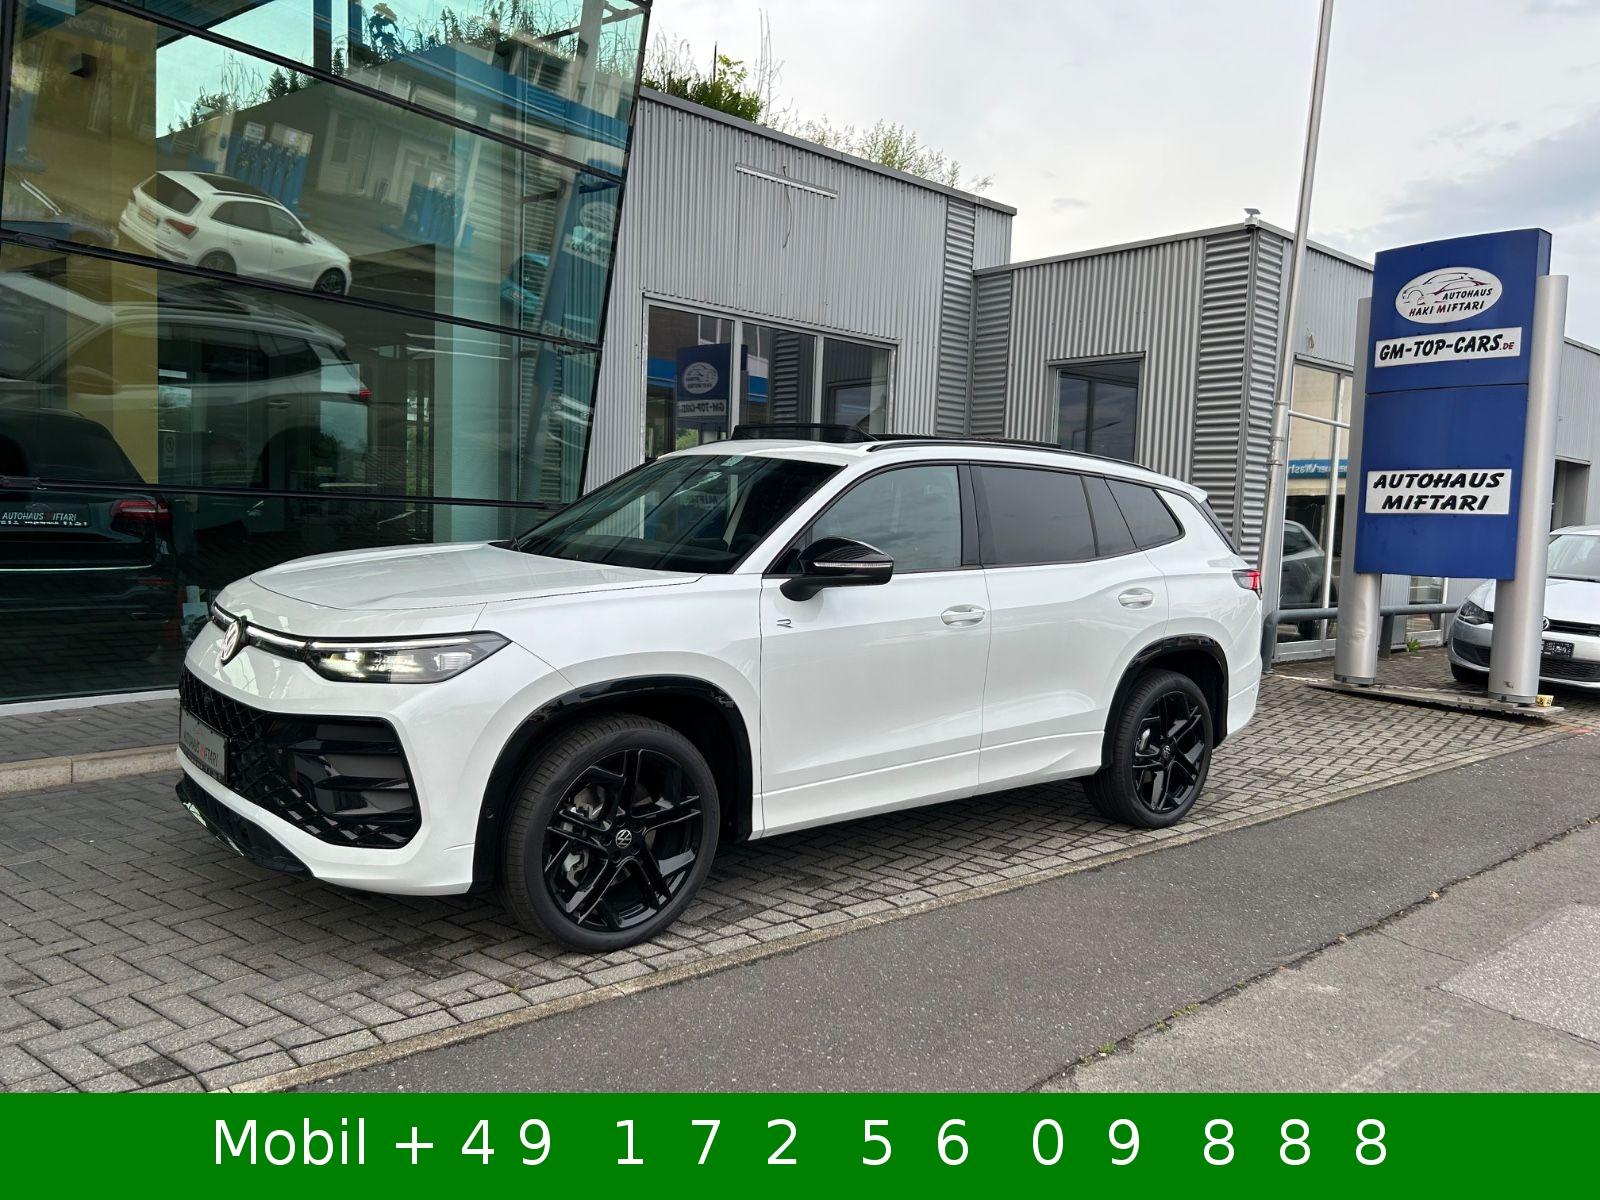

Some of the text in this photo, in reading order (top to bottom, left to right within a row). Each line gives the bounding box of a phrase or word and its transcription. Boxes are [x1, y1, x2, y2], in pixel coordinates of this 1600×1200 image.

[1442, 288, 1493, 300] AUTOHAUS
[1408, 300, 1485, 317] HAKI MIFTARI
[1379, 333, 1515, 361] GM-TOP-CARS.DE
[1373, 472, 1505, 489] AUTOHAUS
[1381, 495, 1490, 511] MIFTARI
[2, 512, 44, 520] AUTOHAUS
